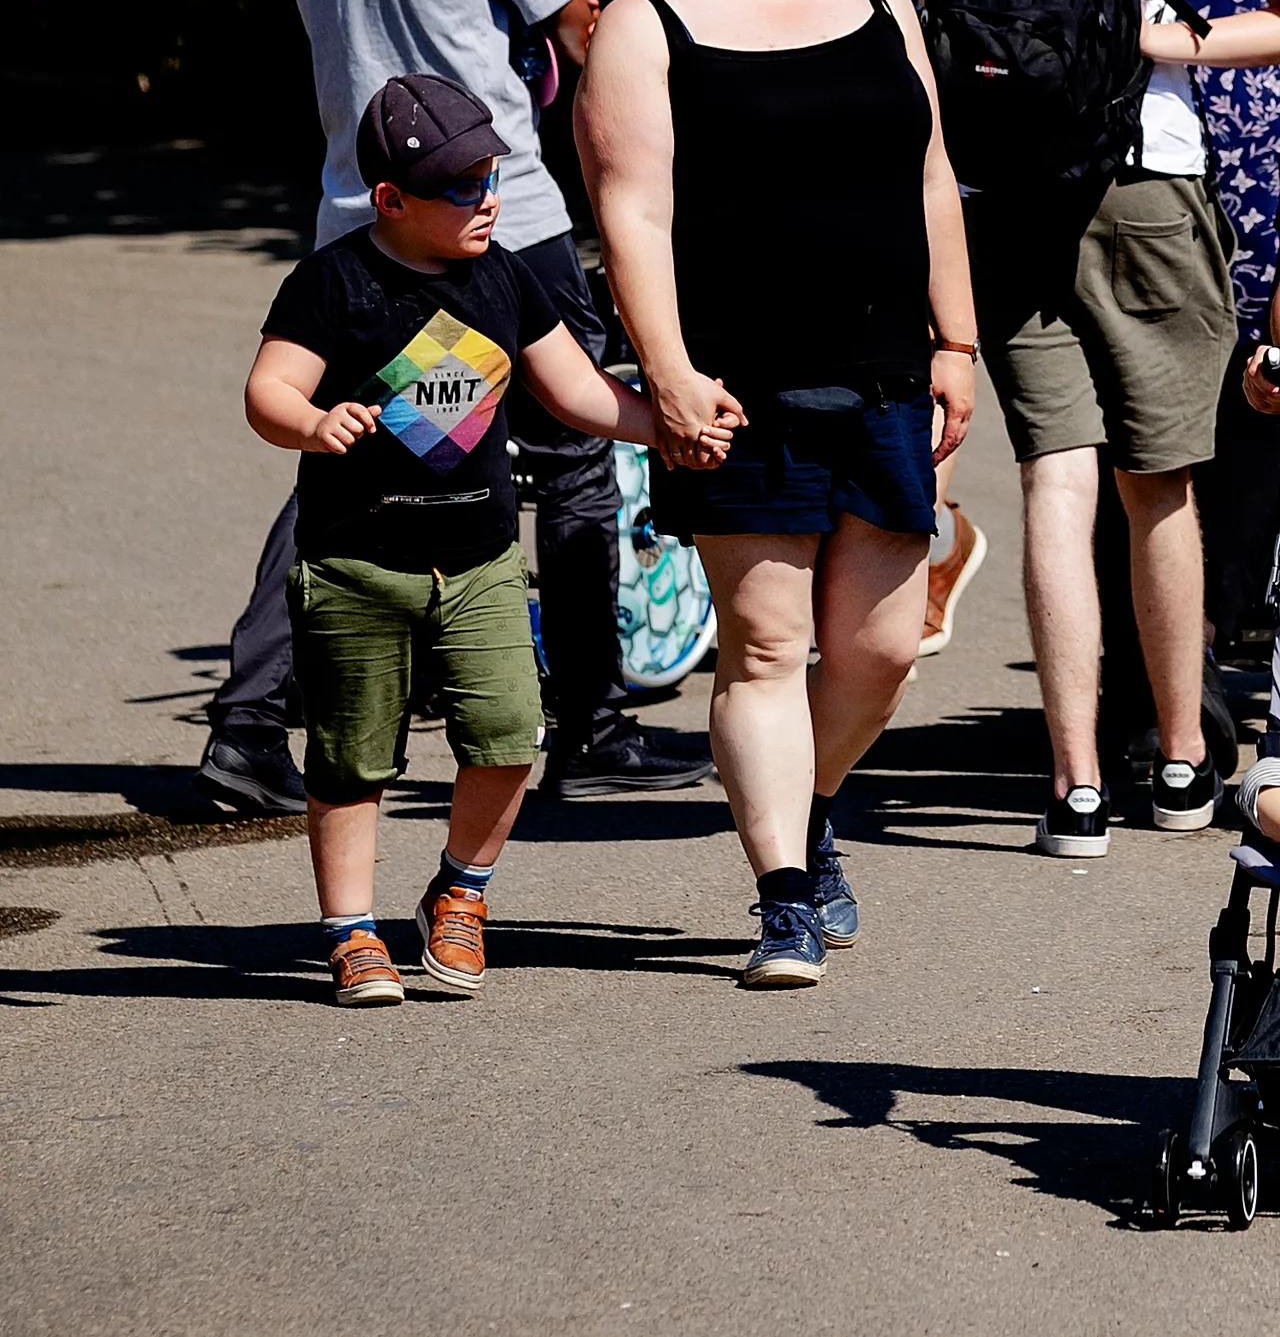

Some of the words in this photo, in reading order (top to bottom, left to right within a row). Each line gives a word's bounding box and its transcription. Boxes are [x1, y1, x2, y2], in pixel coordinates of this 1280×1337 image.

[434, 371, 465, 379] SINCE
[415, 378, 482, 406] NMT
[1165, 771, 1189, 779] adidas
[1072, 796, 1097, 804] adidas
